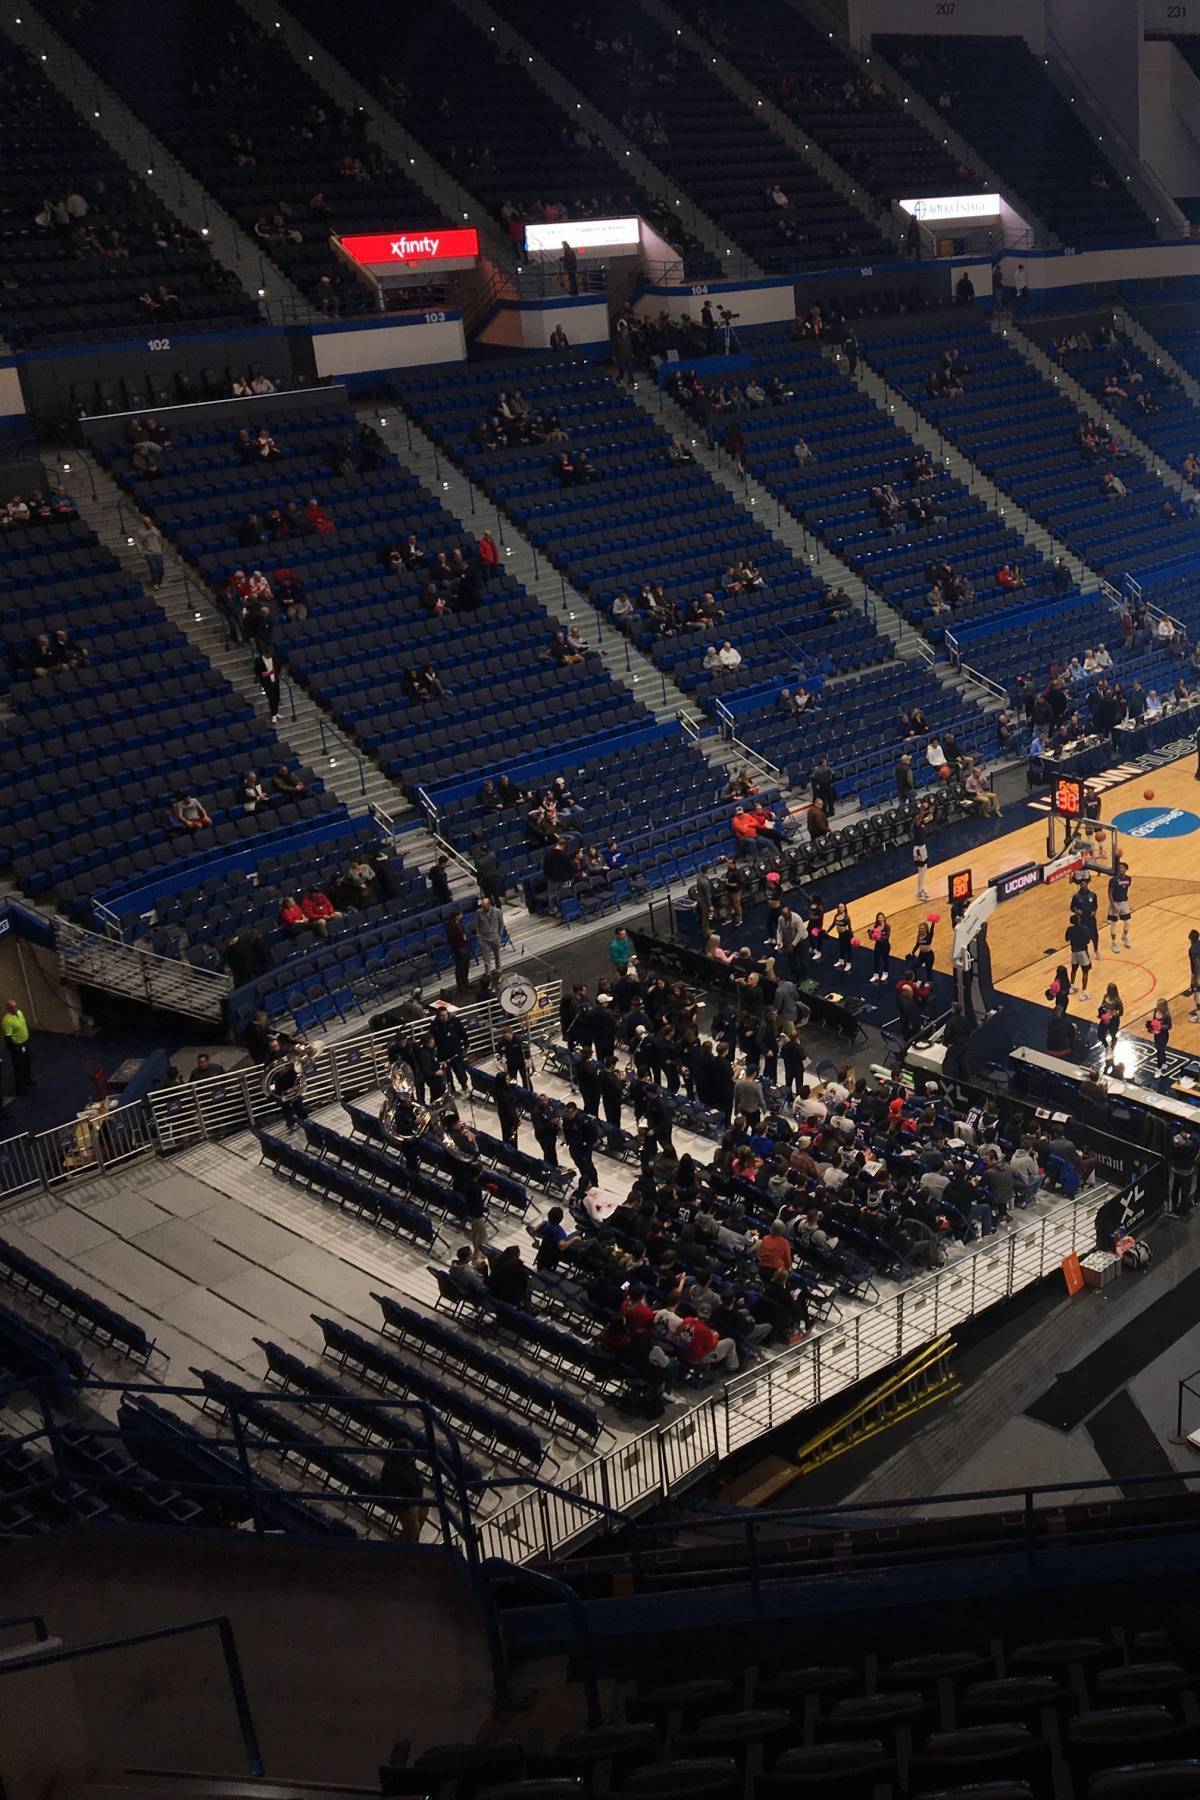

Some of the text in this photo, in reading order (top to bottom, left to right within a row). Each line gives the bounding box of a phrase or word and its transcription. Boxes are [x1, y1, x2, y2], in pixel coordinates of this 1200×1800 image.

[936, 4, 955, 15] 207
[1168, 6, 1186, 17] 231
[390, 236, 439, 257] xfinity
[691, 286, 708, 295] 104
[424, 312, 445, 323] 103
[147, 339, 171, 351] 102
[1058, 779, 1080, 792] 15:48
[1005, 870, 1037, 894] UCONN
[1120, 1185, 1145, 1223] XL
[1126, 1208, 1145, 1227] CENTER
